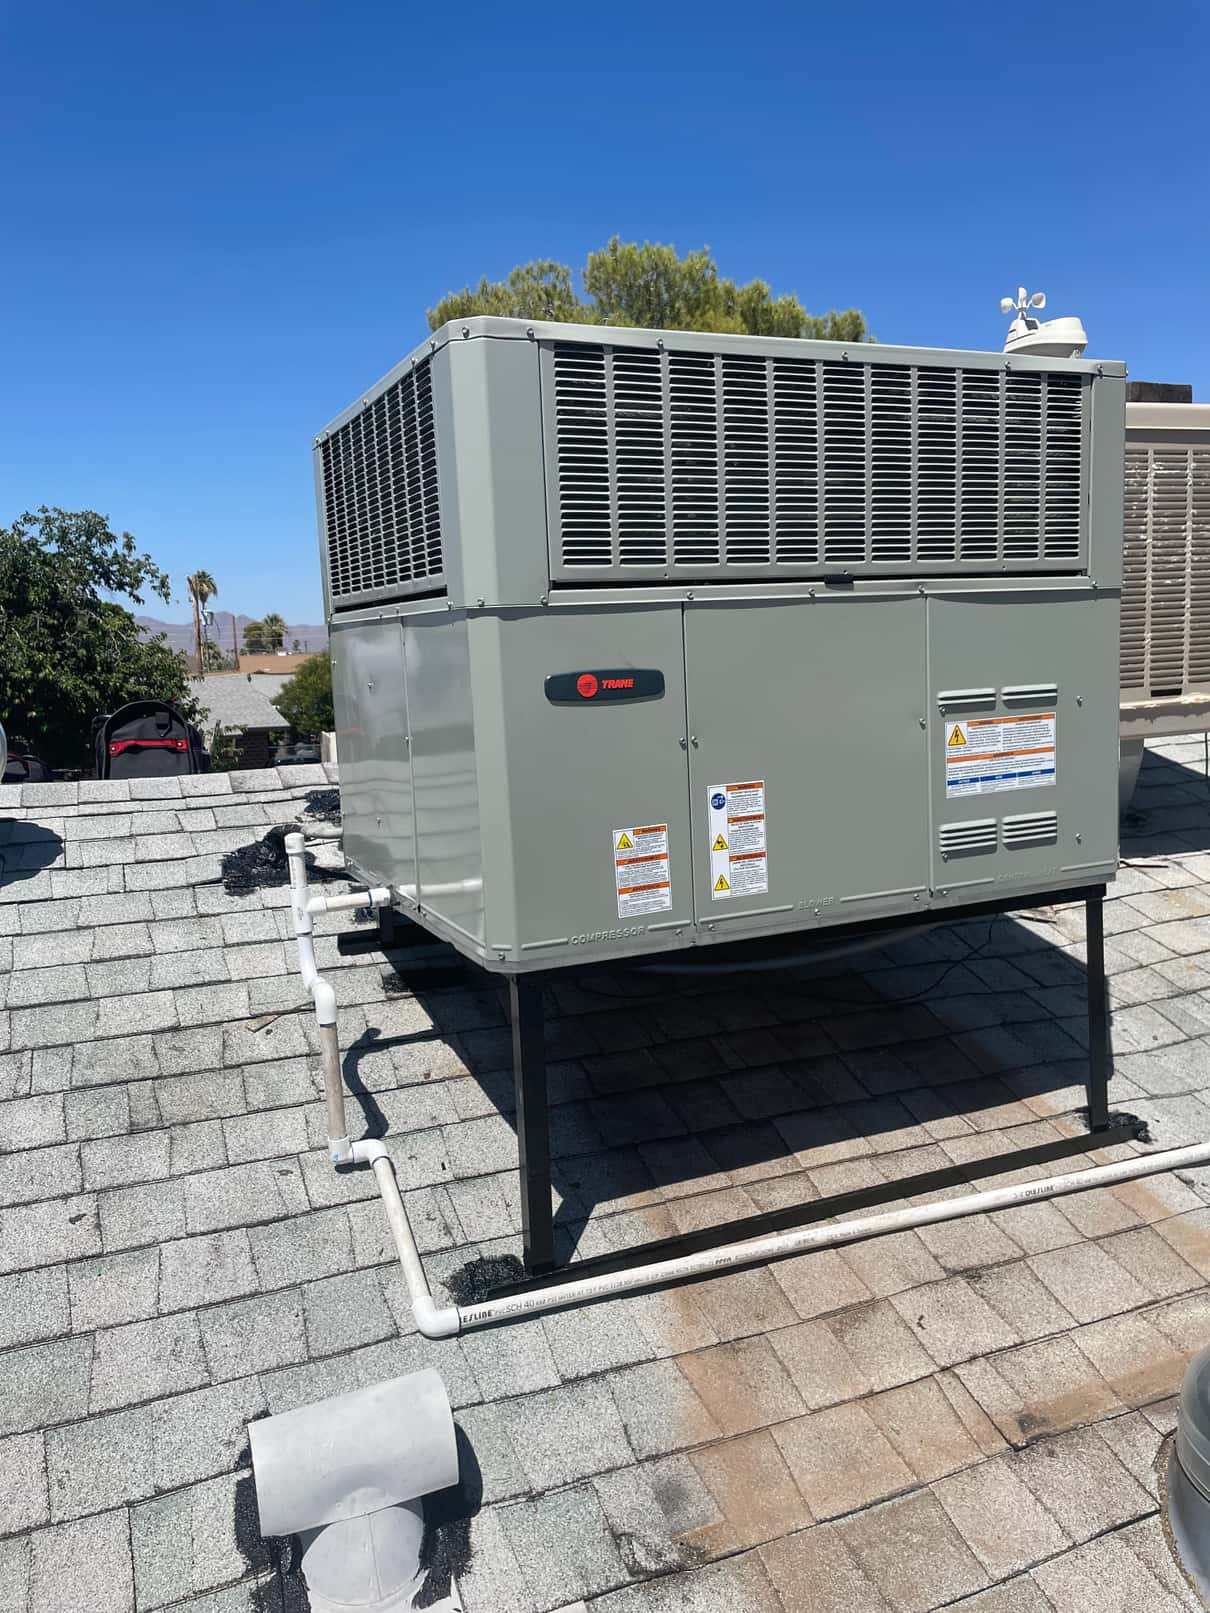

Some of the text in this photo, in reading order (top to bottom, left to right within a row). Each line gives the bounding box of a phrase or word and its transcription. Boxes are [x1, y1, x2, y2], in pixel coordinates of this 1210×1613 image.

[601, 679, 634, 689] TRANE
[570, 925, 645, 945] COMPRESSOR
[506, 1302, 522, 1313] SCH
[524, 1300, 534, 1309] 40
